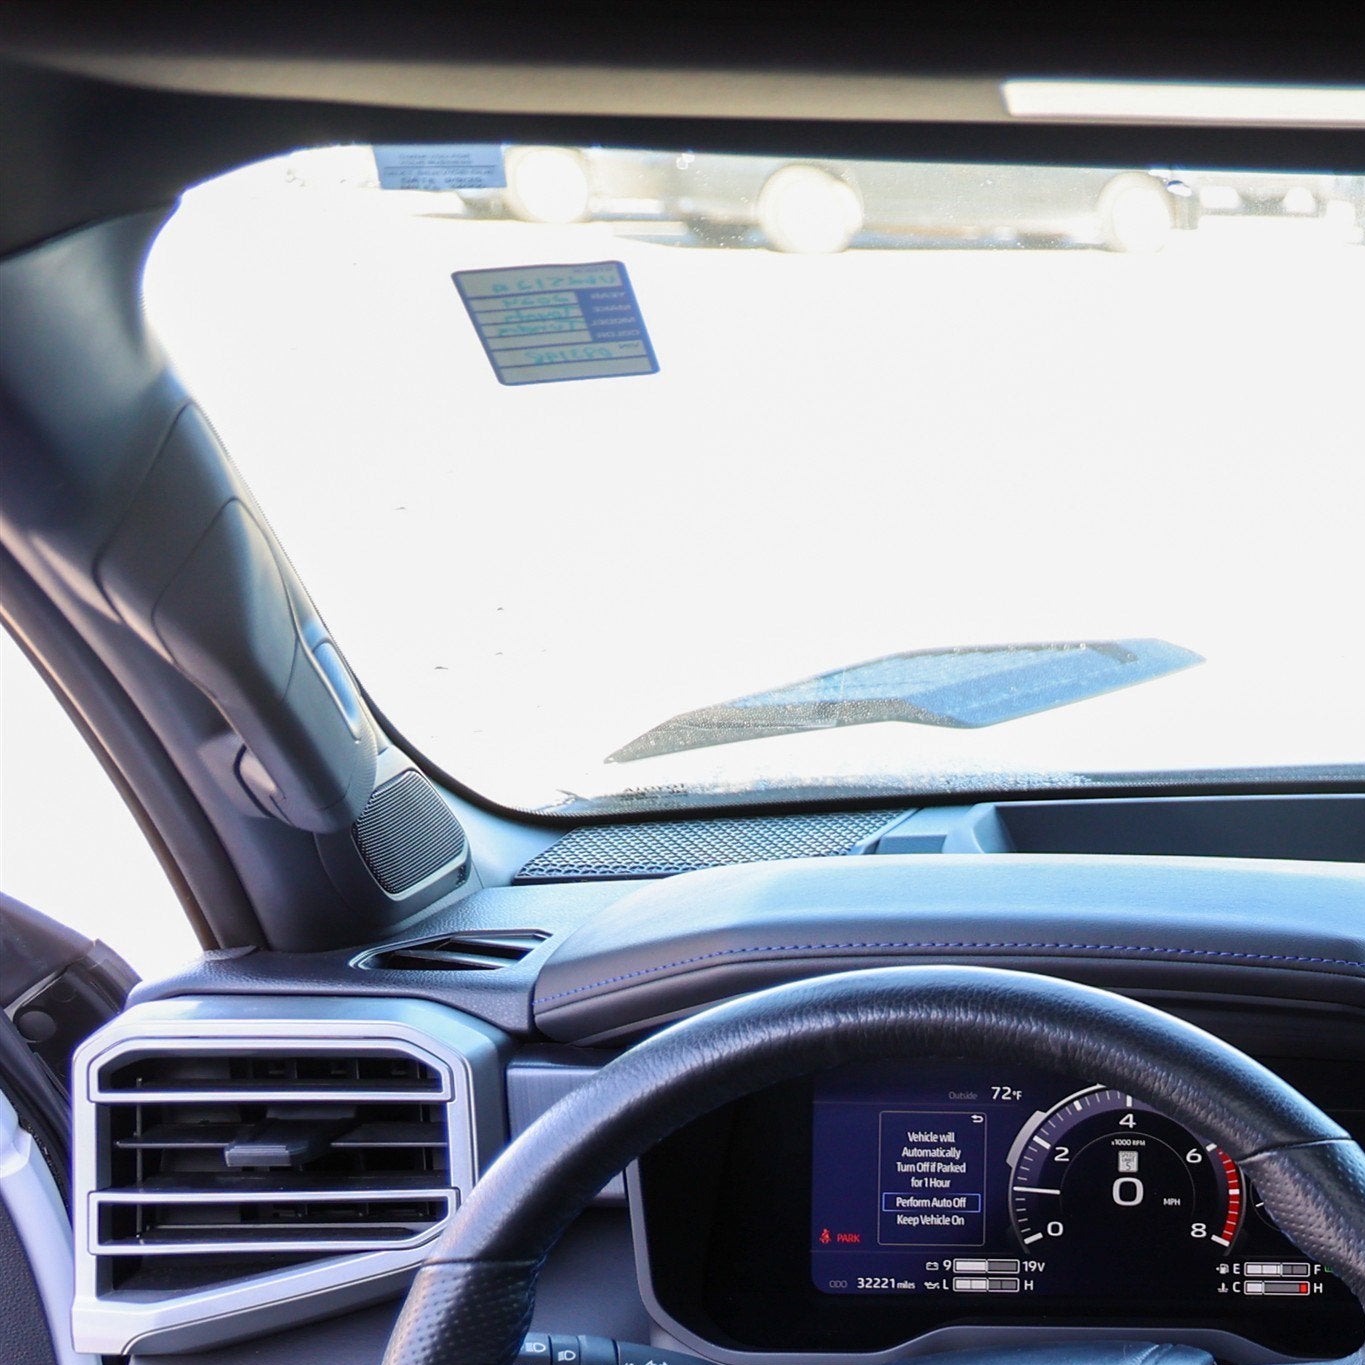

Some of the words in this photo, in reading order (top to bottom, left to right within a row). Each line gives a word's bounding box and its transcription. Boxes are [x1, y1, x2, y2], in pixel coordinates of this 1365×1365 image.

[1119, 1113, 1136, 1129] 4
[907, 1131, 938, 1143] Vehicle
[939, 1131, 956, 1143] will
[901, 1147, 961, 1159] Automatically
[1054, 1148, 1070, 1162] 2
[1186, 1148, 1202, 1164] 6
[896, 1162, 915, 1173] Turn
[916, 1162, 930, 1173] Off
[930, 1162, 936, 1173] if
[937, 1162, 966, 1174] Parked
[911, 1177, 923, 1188] for
[929, 1178, 951, 1188] Hour
[1112, 1177, 1144, 1206] 0
[896, 1197, 930, 1208] Perform
[931, 1197, 952, 1208] Auto
[952, 1197, 966, 1208] Off
[1163, 1198, 1181, 1206] MPH
[897, 1215, 919, 1227] Keep
[920, 1215, 950, 1226] Vehicle
[951, 1215, 965, 1226] On
[1047, 1222, 1063, 1236] 0
[1190, 1222, 1207, 1238] 8
[836, 1233, 861, 1243] PARK
[943, 1260, 952, 1272] 9
[1022, 1261, 1045, 1272] 19V
[1233, 1263, 1240, 1274] E
[1314, 1264, 1321, 1274] F
[857, 1277, 895, 1289] 32221
[896, 1280, 915, 1290] miles
[942, 1280, 949, 1290] L
[1024, 1280, 1033, 1290] H
[1232, 1281, 1240, 1292] C
[1314, 1282, 1322, 1293] H
